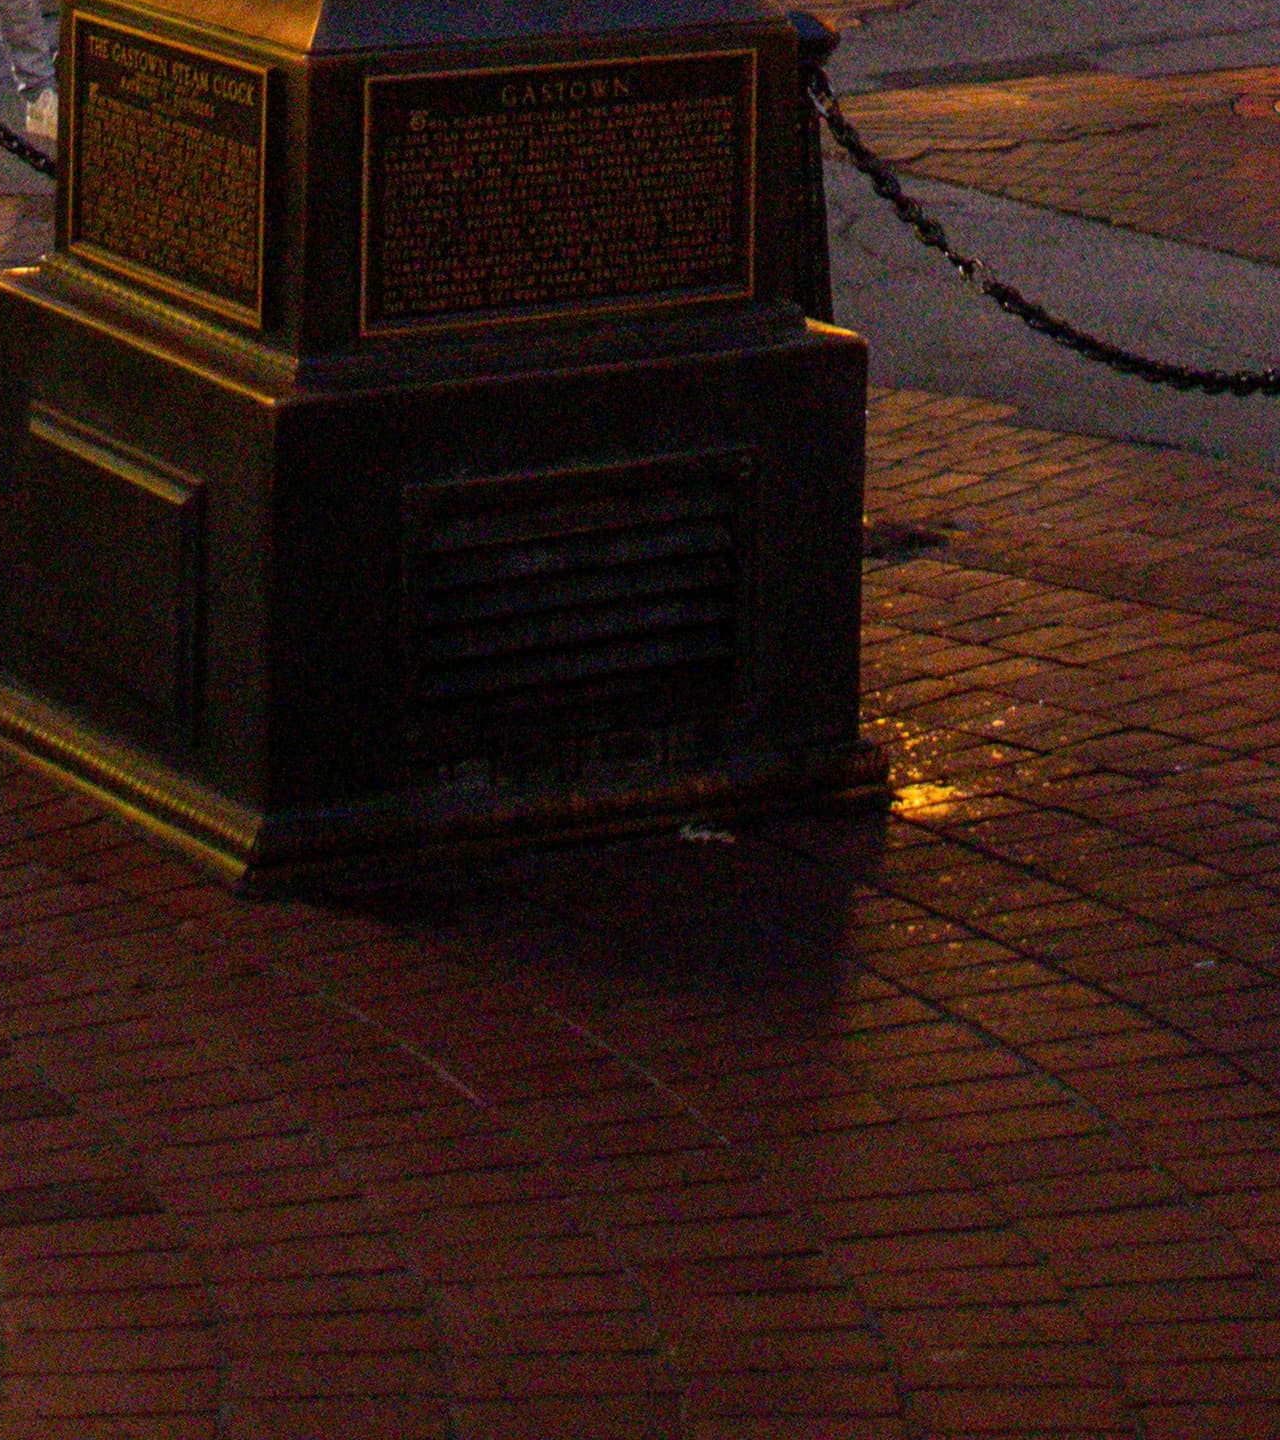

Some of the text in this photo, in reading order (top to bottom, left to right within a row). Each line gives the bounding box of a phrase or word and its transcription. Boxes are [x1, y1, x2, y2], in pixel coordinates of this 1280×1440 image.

[87, 35, 110, 61] THE
[112, 41, 168, 78] GASTOWN
[172, 64, 211, 93] STEAM
[212, 77, 256, 107] CLOCK
[500, 74, 630, 107] GASTOWN
